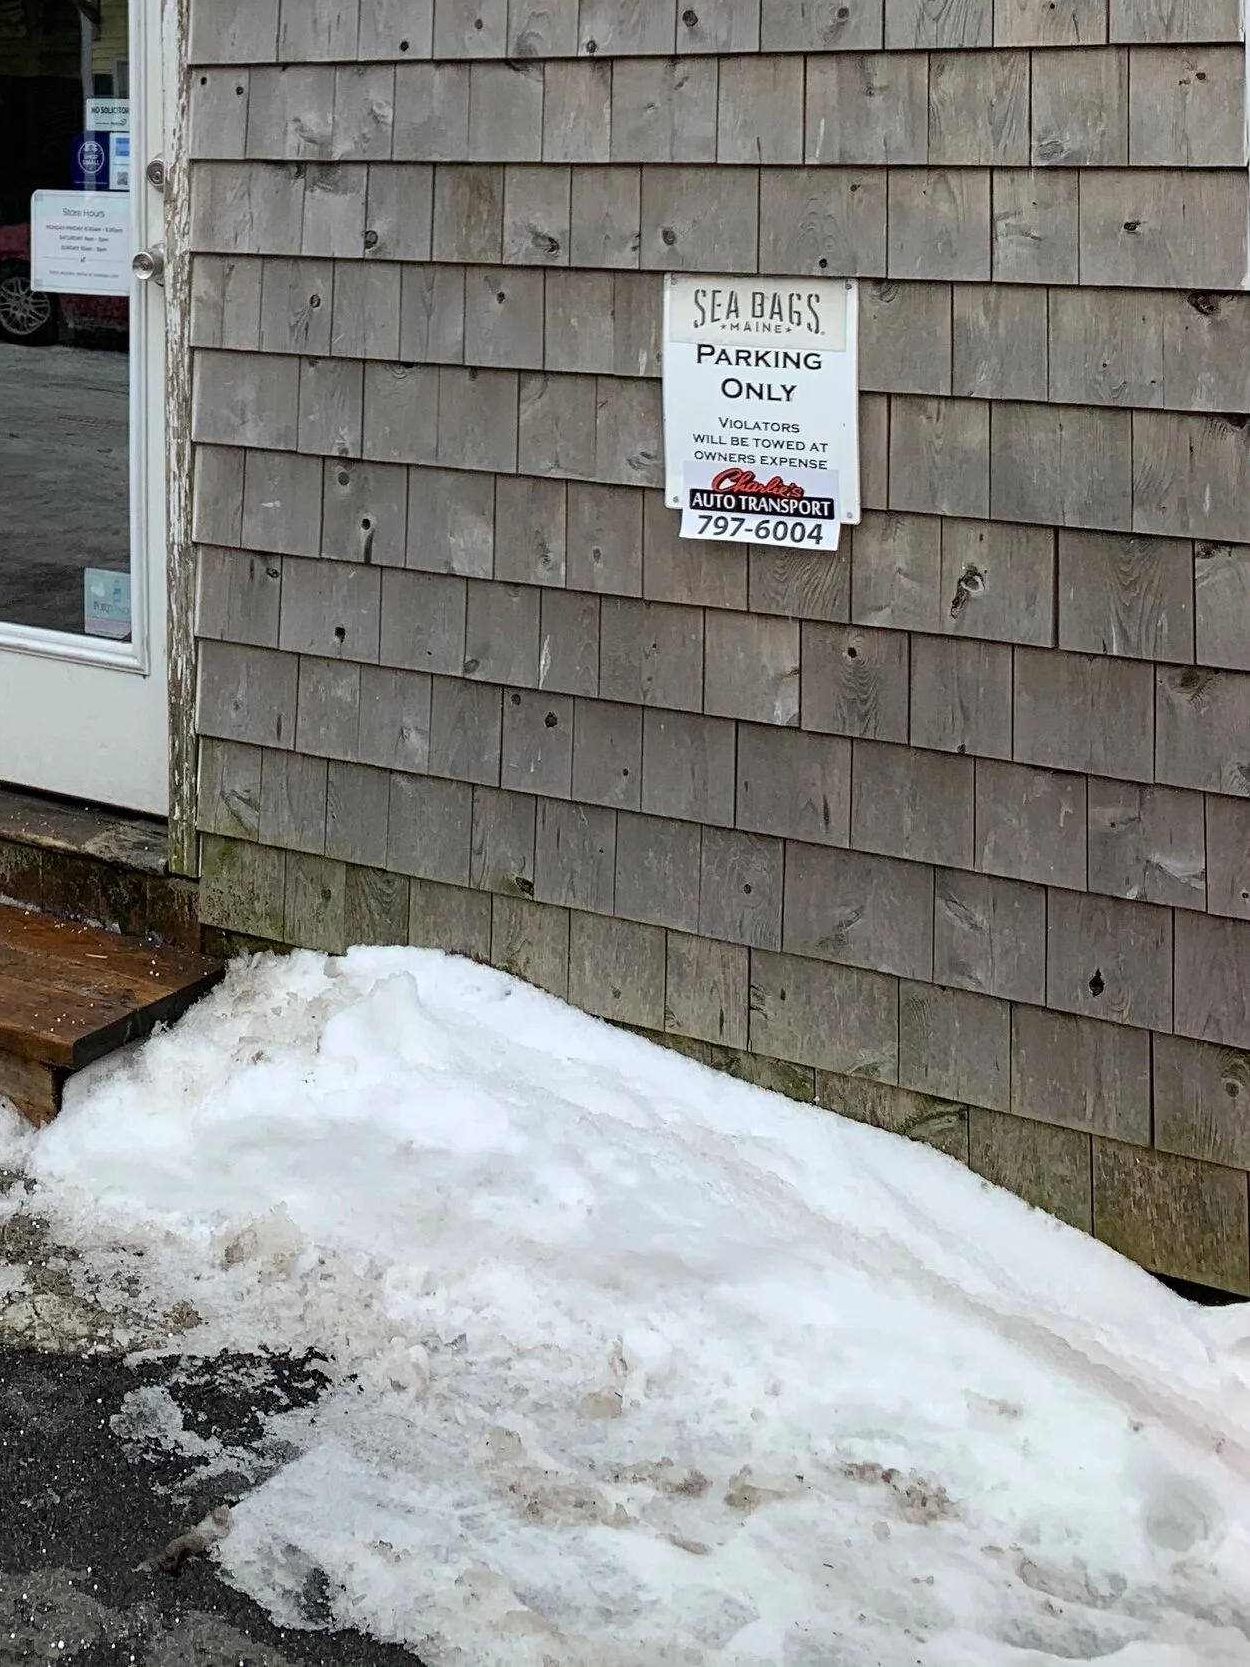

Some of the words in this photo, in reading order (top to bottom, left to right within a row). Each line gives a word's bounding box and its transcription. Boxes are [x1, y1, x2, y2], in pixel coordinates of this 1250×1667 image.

[62, 207, 82, 217] Store
[83, 208, 105, 218] Hours
[693, 289, 739, 329] SEA
[751, 291, 820, 335] BAGS
[730, 321, 782, 334] MAINE
[696, 343, 822, 370] PARKING
[721, 377, 797, 402] ONLY
[718, 416, 800, 433] VIOLATORS
[692, 433, 727, 445] WILL
[730, 436, 749, 447] BE
[752, 438, 806, 451] TOWED
[809, 442, 829, 453] AT
[694, 450, 756, 464] OWNERS
[760, 455, 828, 470] EXPENSE
[711, 467, 805, 499] Charlie's
[692, 492, 736, 509] AUTO
[738, 495, 831, 516] TRANSPORT
[697, 515, 823, 545] 797-6004
